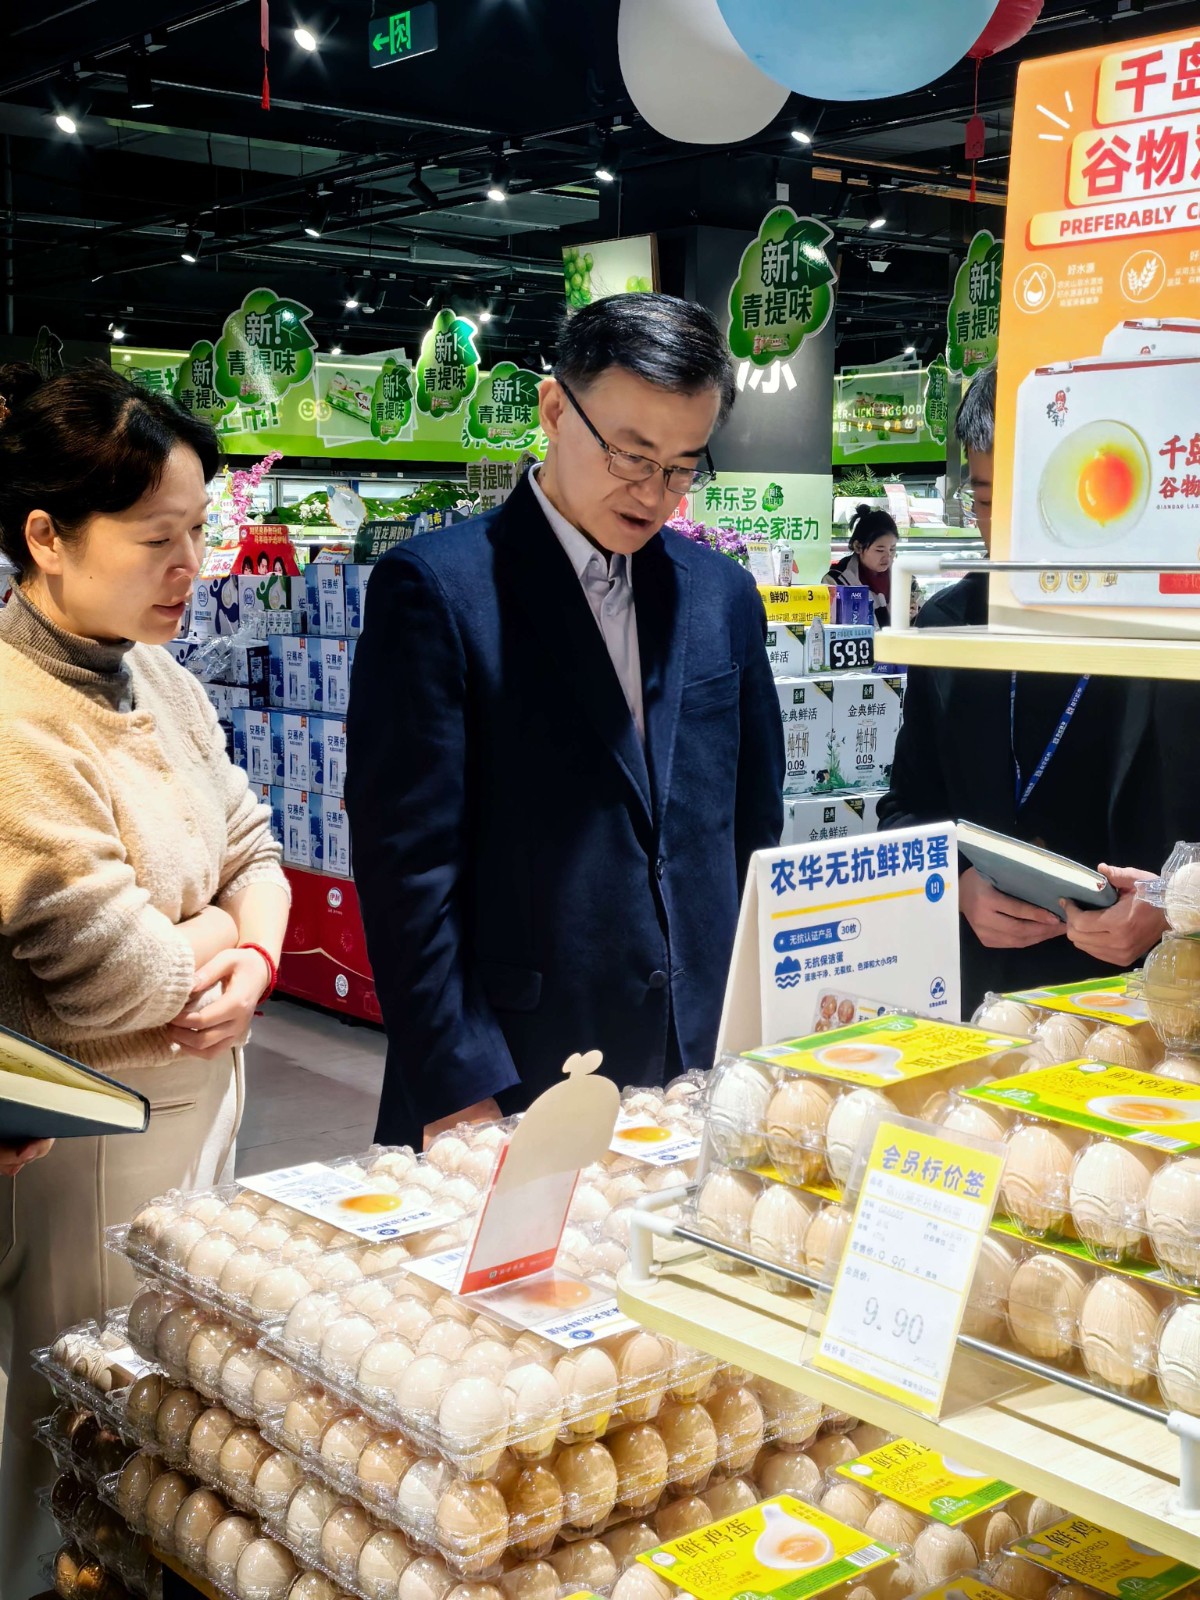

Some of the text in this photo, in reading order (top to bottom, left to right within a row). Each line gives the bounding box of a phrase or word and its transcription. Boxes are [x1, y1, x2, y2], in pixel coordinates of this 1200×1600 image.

[1082, 125, 1200, 197] 谷物
[1060, 205, 1176, 237] PREFERABLY
[742, 288, 812, 328] 青提味
[227, 349, 297, 376] 青提味
[424, 366, 467, 392] 青提味
[375, 400, 406, 422] 青提味
[478, 405, 532, 425] 青提味
[468, 463, 513, 490] 青提味
[705, 486, 757, 511] 养乐多
[718, 516, 819, 540] 守护全家活力
[769, 591, 789, 603] 鲜奶
[833, 640, 869, 667] 59.0
[780, 707, 818, 722] 金典鲜活
[847, 703, 887, 718] 金典鲜活
[809, 826, 848, 841] 金典鲜活
[770, 834, 949, 897] 农华无抗鲜鸡蛋
[789, 923, 857, 946] 无抗认证产品 30枚
[804, 951, 844, 970] 无抗保洁蛋
[882, 1144, 986, 1199] 会员标价签
[674, 1518, 758, 1559] 鲜鸡蛋
[678, 1549, 737, 1579] PREFERRED
[1055, 1540, 1109, 1566] PREFERRED
[1067, 1555, 1103, 1571] GRASS
[685, 1564, 725, 1584] GRASS
[694, 1572, 728, 1589] EGGS
[1074, 1562, 1109, 1576] EGGS
